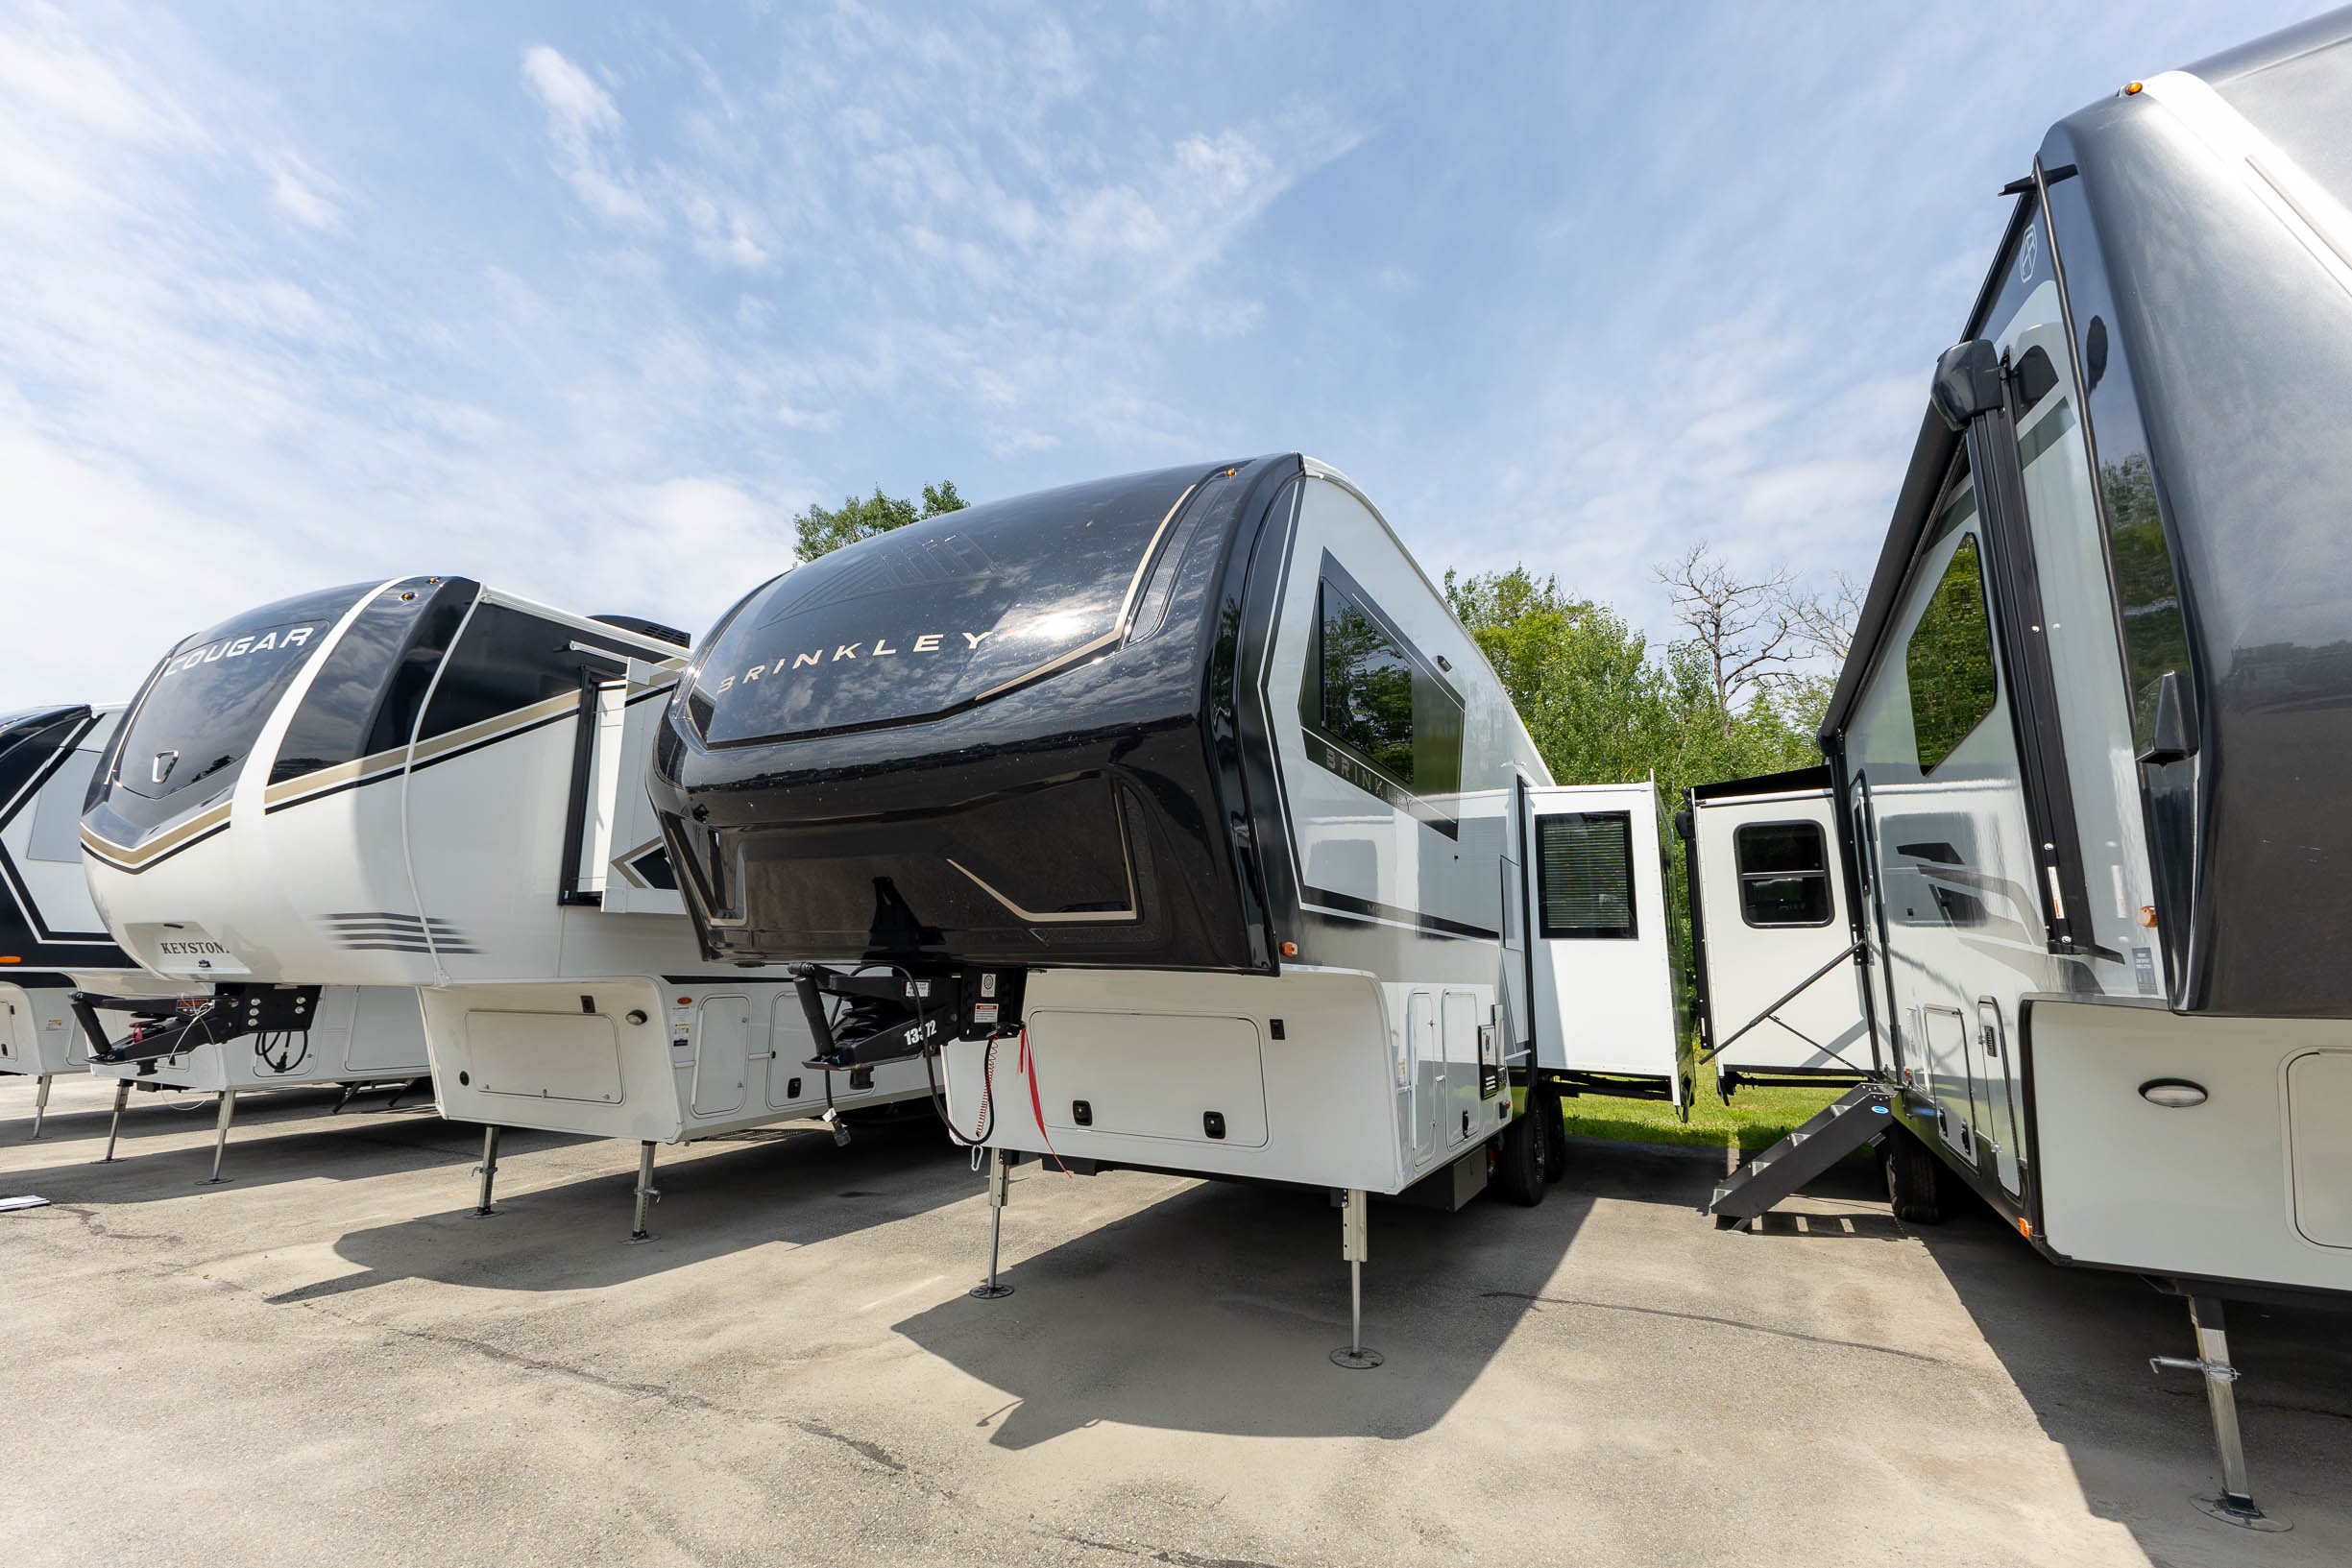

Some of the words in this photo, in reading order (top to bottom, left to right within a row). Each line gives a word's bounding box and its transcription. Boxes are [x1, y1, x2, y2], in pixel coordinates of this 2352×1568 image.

[163, 627, 314, 678] COUGAR
[716, 631, 993, 694] BRINKLEY
[1326, 748, 1414, 812] BRINKLEY
[160, 941, 230, 954] KEYSTON
